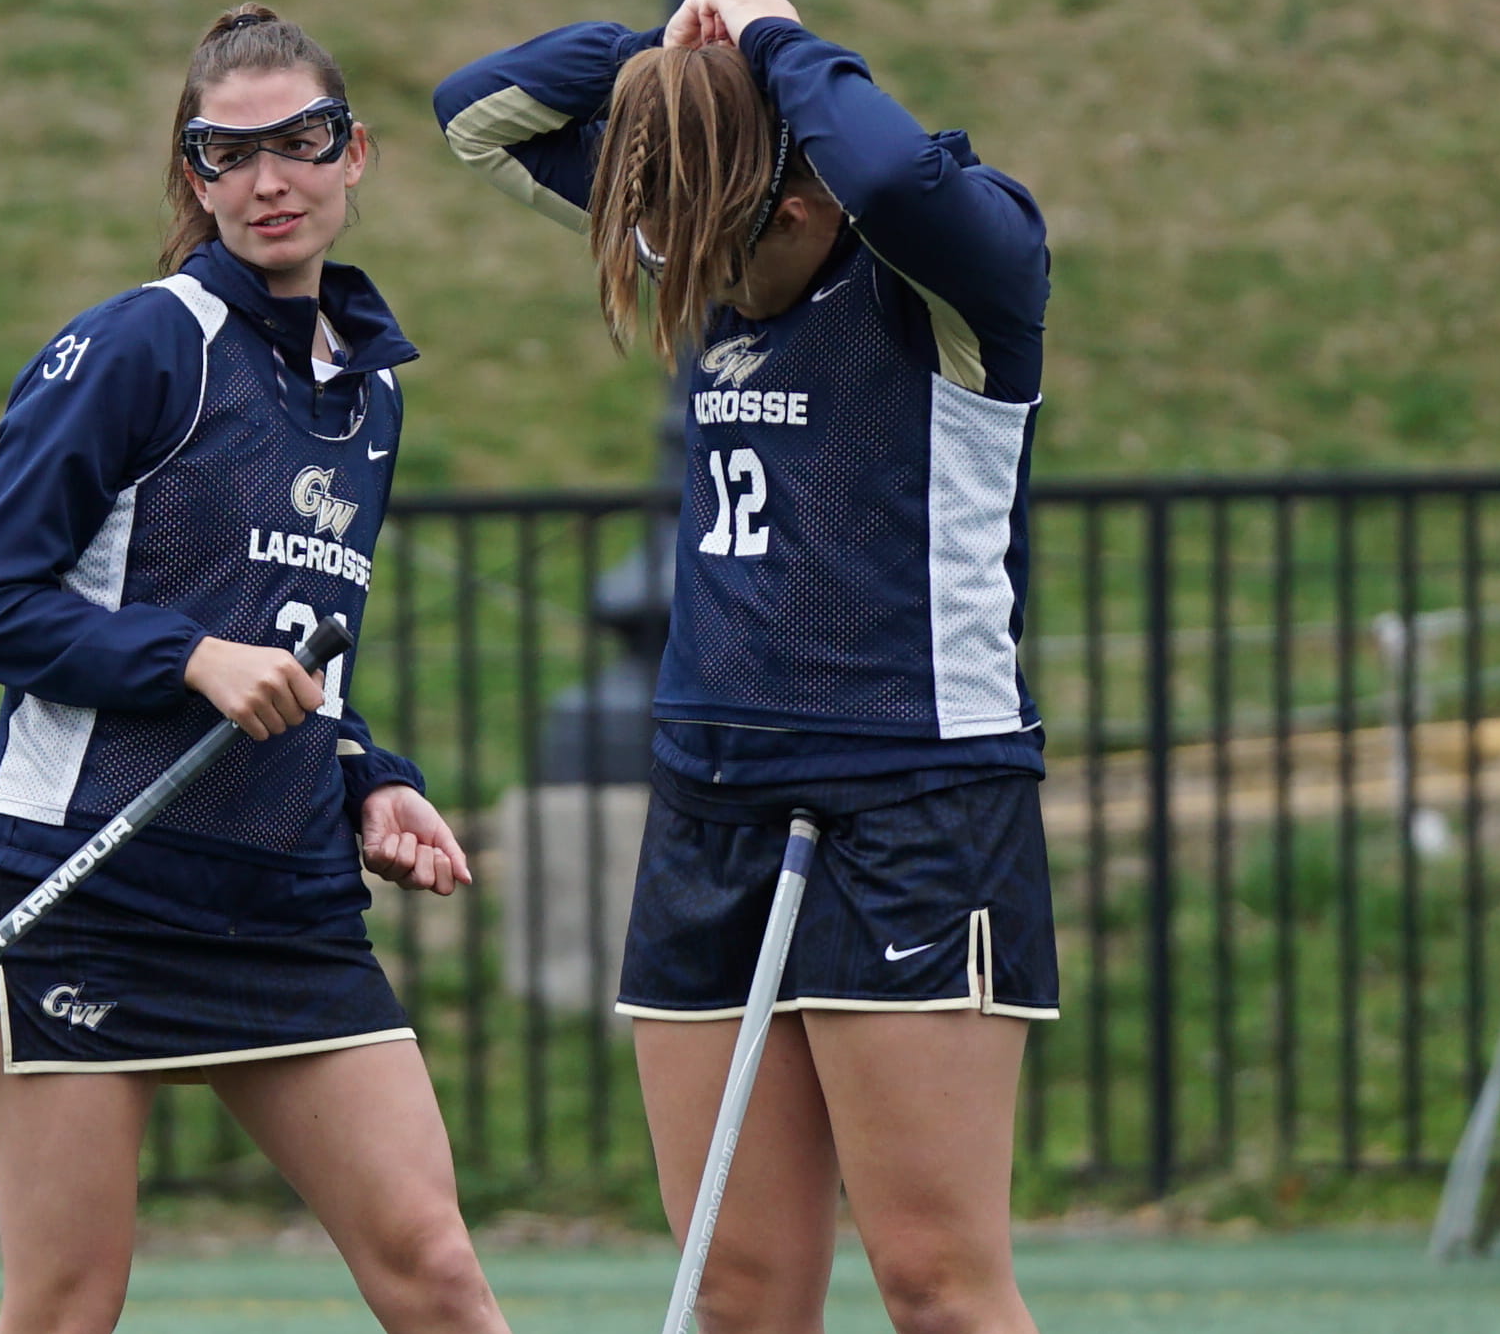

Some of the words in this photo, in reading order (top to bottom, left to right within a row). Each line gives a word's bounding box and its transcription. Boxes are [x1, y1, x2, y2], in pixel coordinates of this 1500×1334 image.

[770, 118, 790, 194] ARMOU
[43, 334, 91, 381] 31
[694, 390, 809, 425] CROSSE
[291, 465, 359, 540] GW
[698, 448, 770, 556] 12
[10, 816, 133, 935] ARMOUR
[40, 982, 117, 1030] GW
